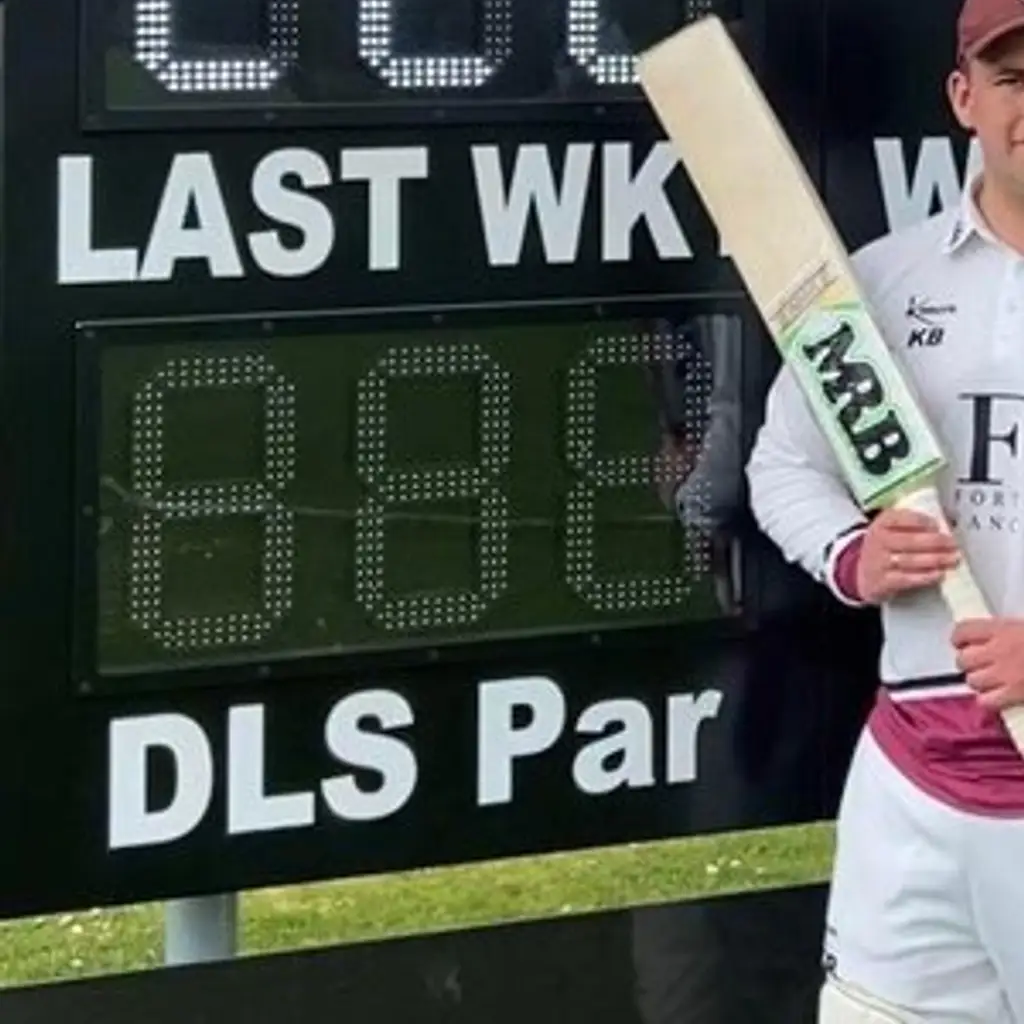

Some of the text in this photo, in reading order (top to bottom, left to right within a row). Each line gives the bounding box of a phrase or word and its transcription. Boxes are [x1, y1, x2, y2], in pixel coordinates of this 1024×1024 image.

[57, 139, 733, 284] LAST WK
[802, 321, 911, 476] MRB
[906, 327, 945, 348] KB
[108, 676, 724, 850] DLS Par
